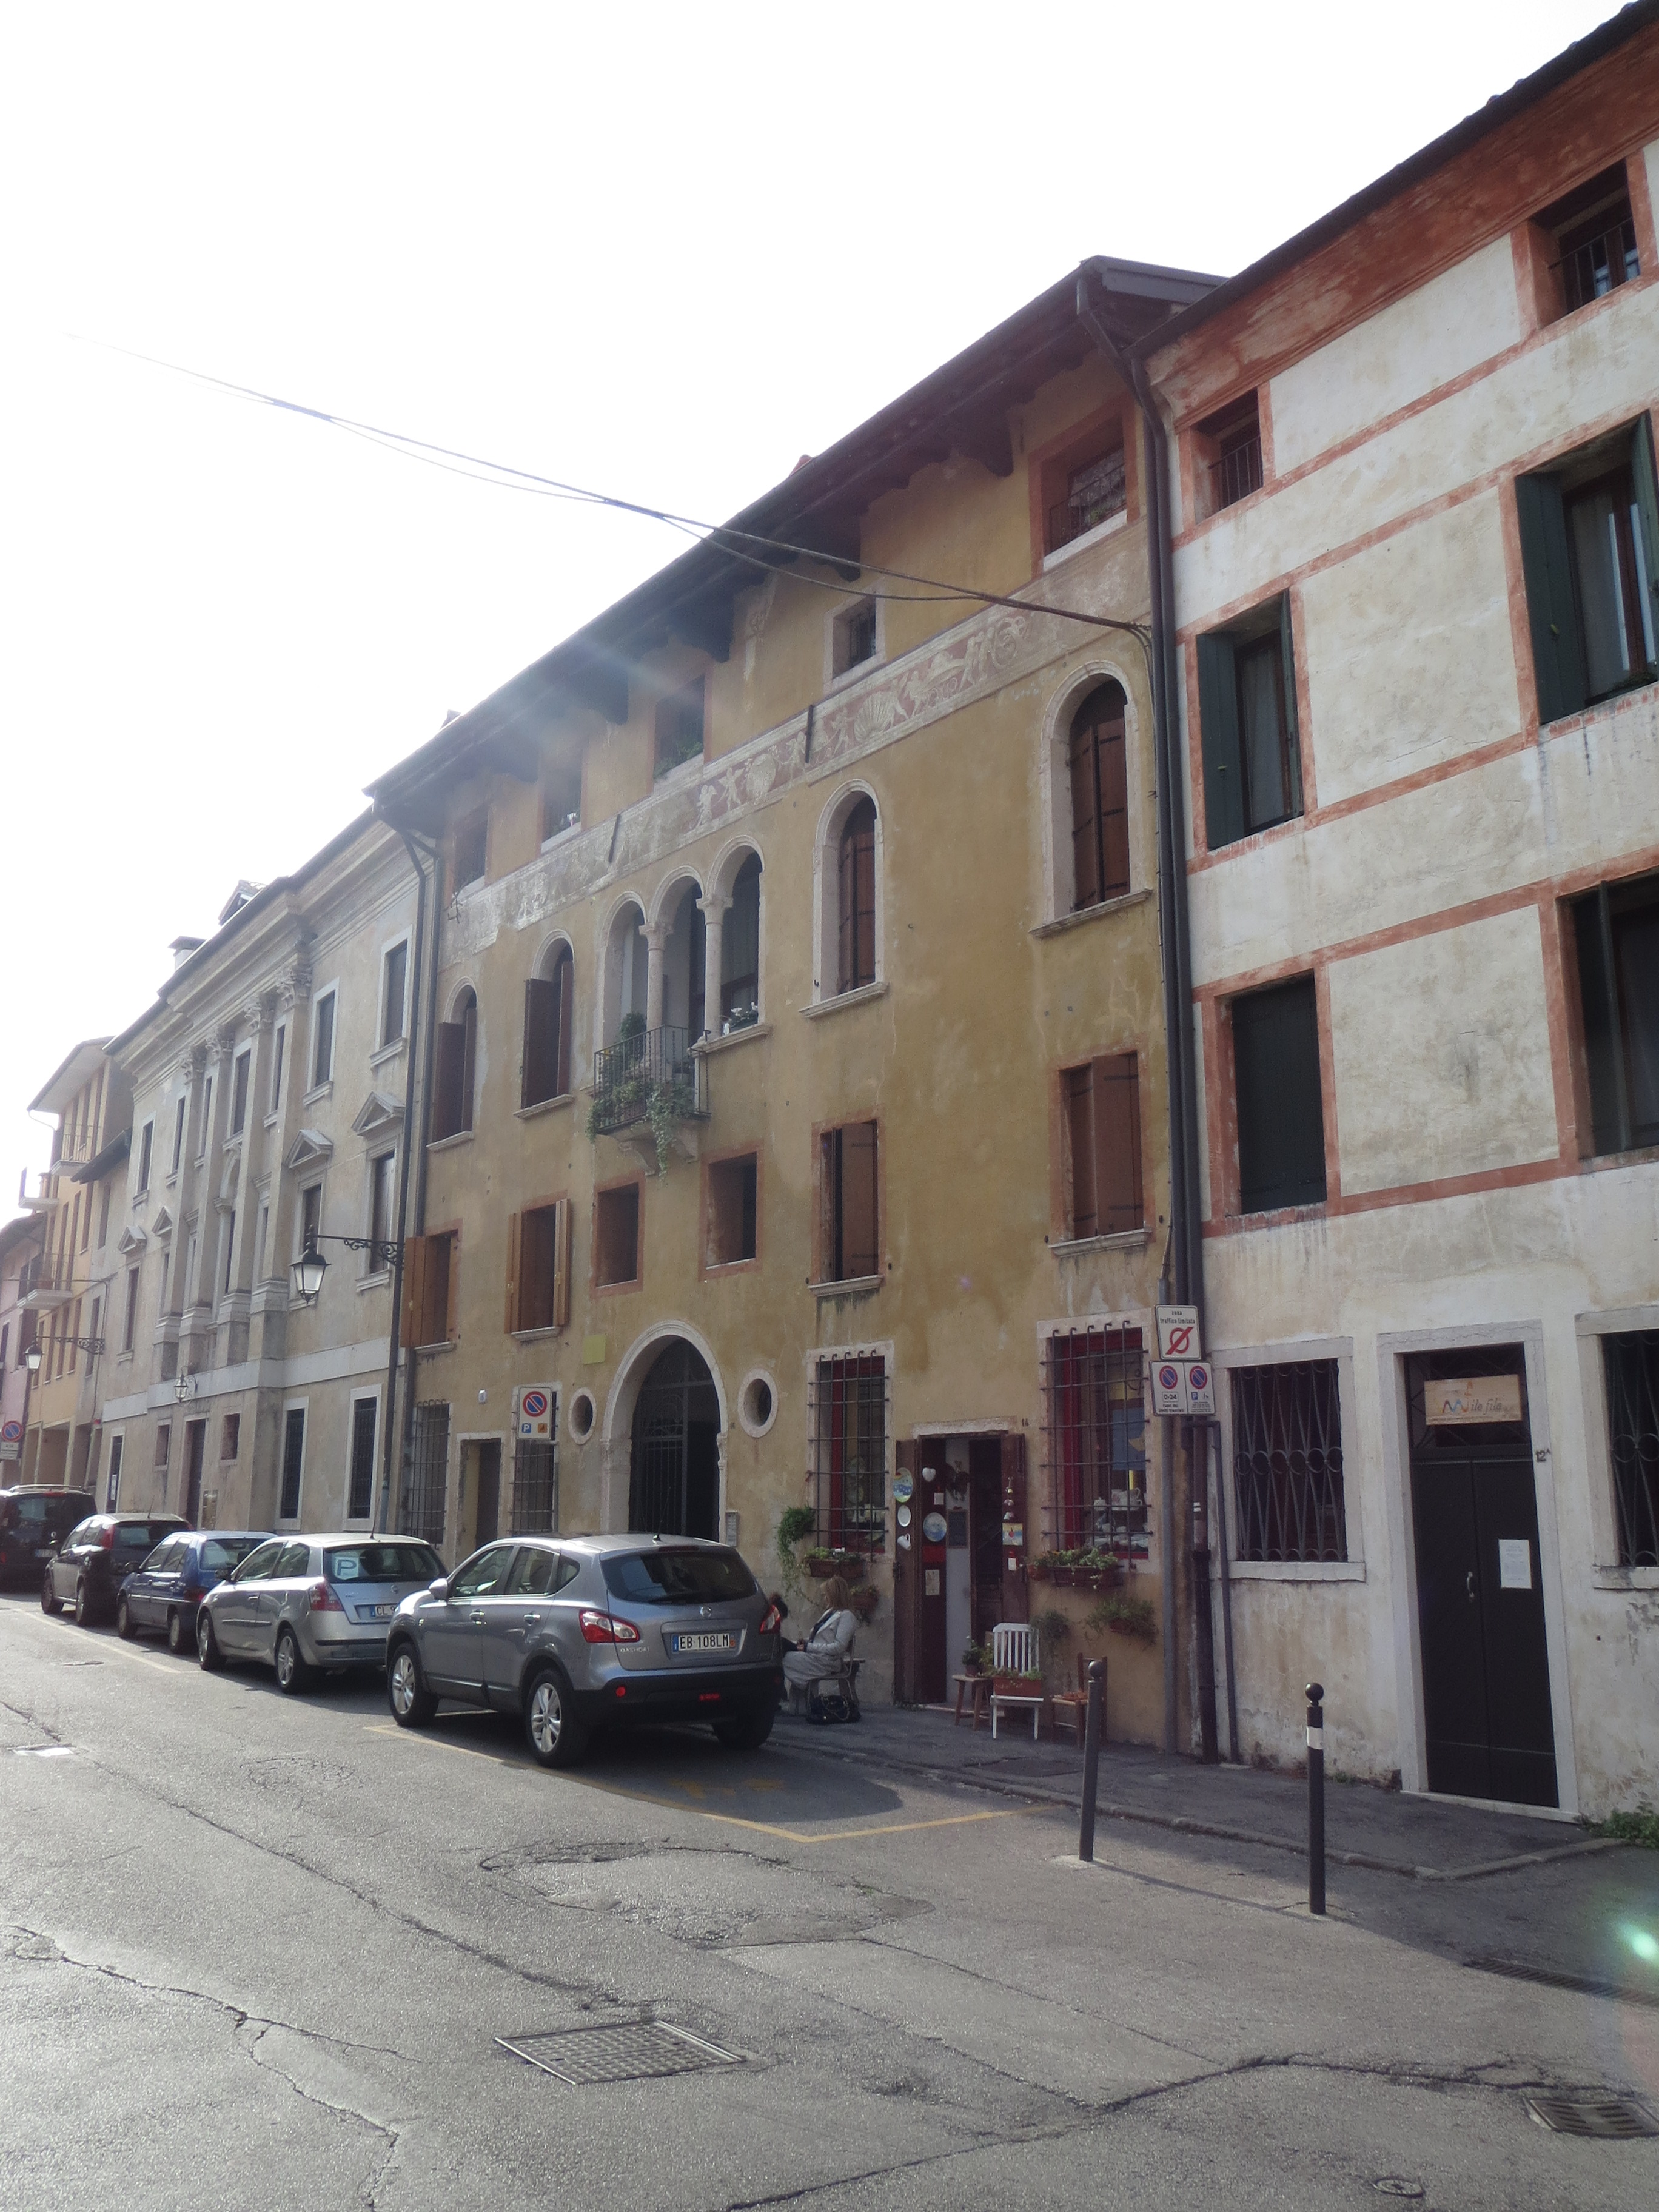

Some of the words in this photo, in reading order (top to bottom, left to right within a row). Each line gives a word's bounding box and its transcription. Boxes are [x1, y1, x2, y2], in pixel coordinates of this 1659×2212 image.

[523, 1424, 530, 1432] P
[337, 1559, 357, 1576] P
[377, 1606, 387, 1615] CL
[680, 1637, 692, 1649] EB
[697, 1635, 728, 1648] 108LM
